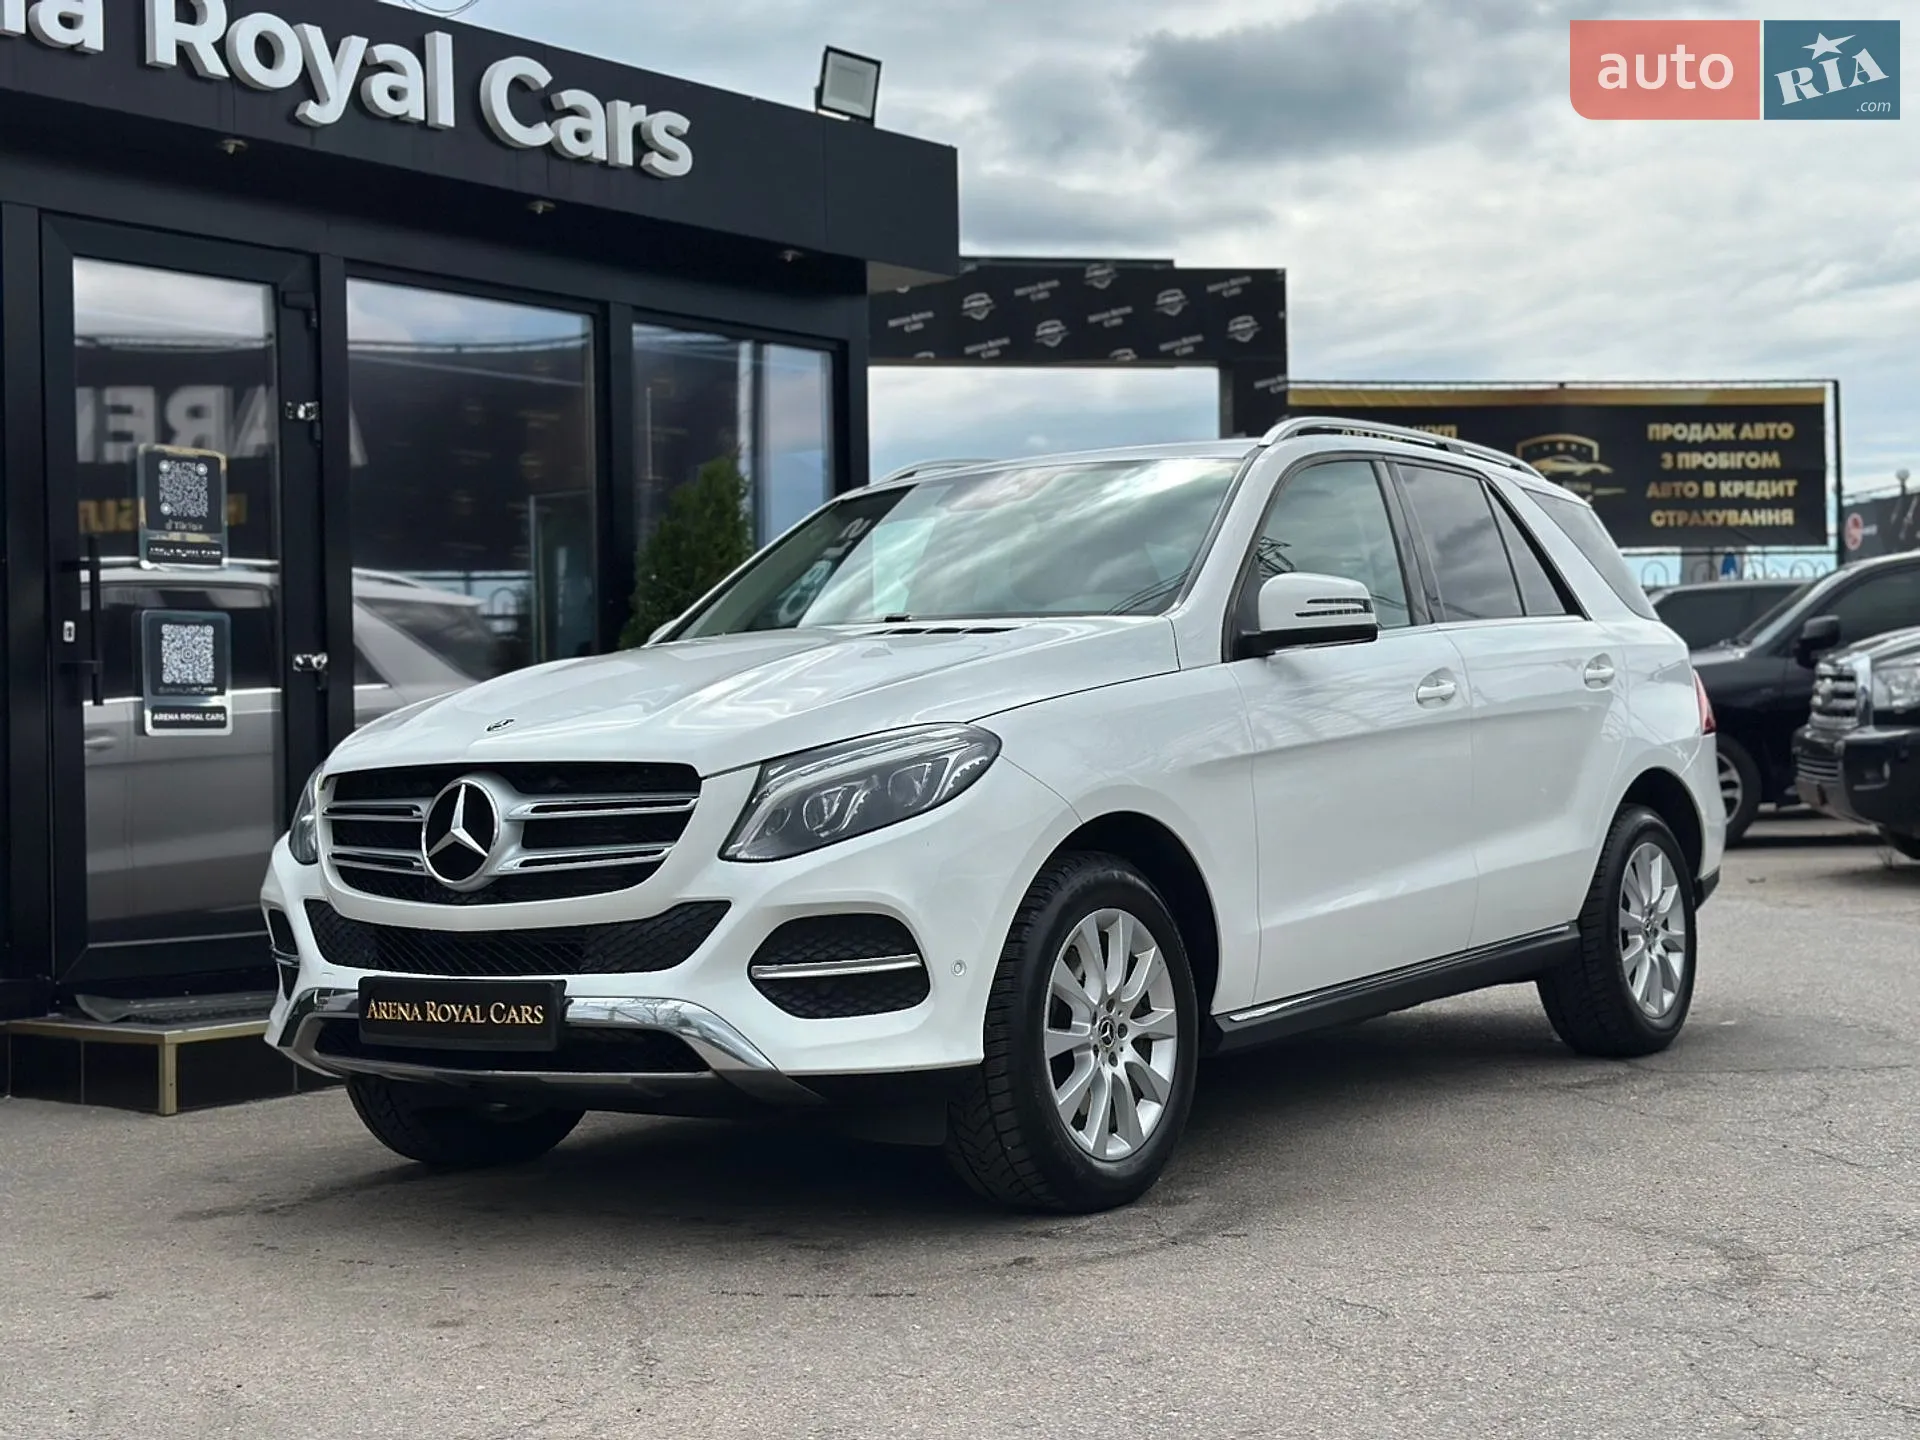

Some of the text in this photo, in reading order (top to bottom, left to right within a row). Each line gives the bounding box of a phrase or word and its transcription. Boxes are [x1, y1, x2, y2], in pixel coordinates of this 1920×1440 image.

[145, 0, 455, 129] Royal
[480, 56, 693, 178] Cars
[1647, 422, 1795, 443] ПРОДАЖ АВТО
[1677, 451, 1781, 469] ПРОБІГОМ
[1646, 479, 1798, 500] АВТО В КРЕДИТ
[1651, 508, 1795, 527] СТРАХУВАННЯ
